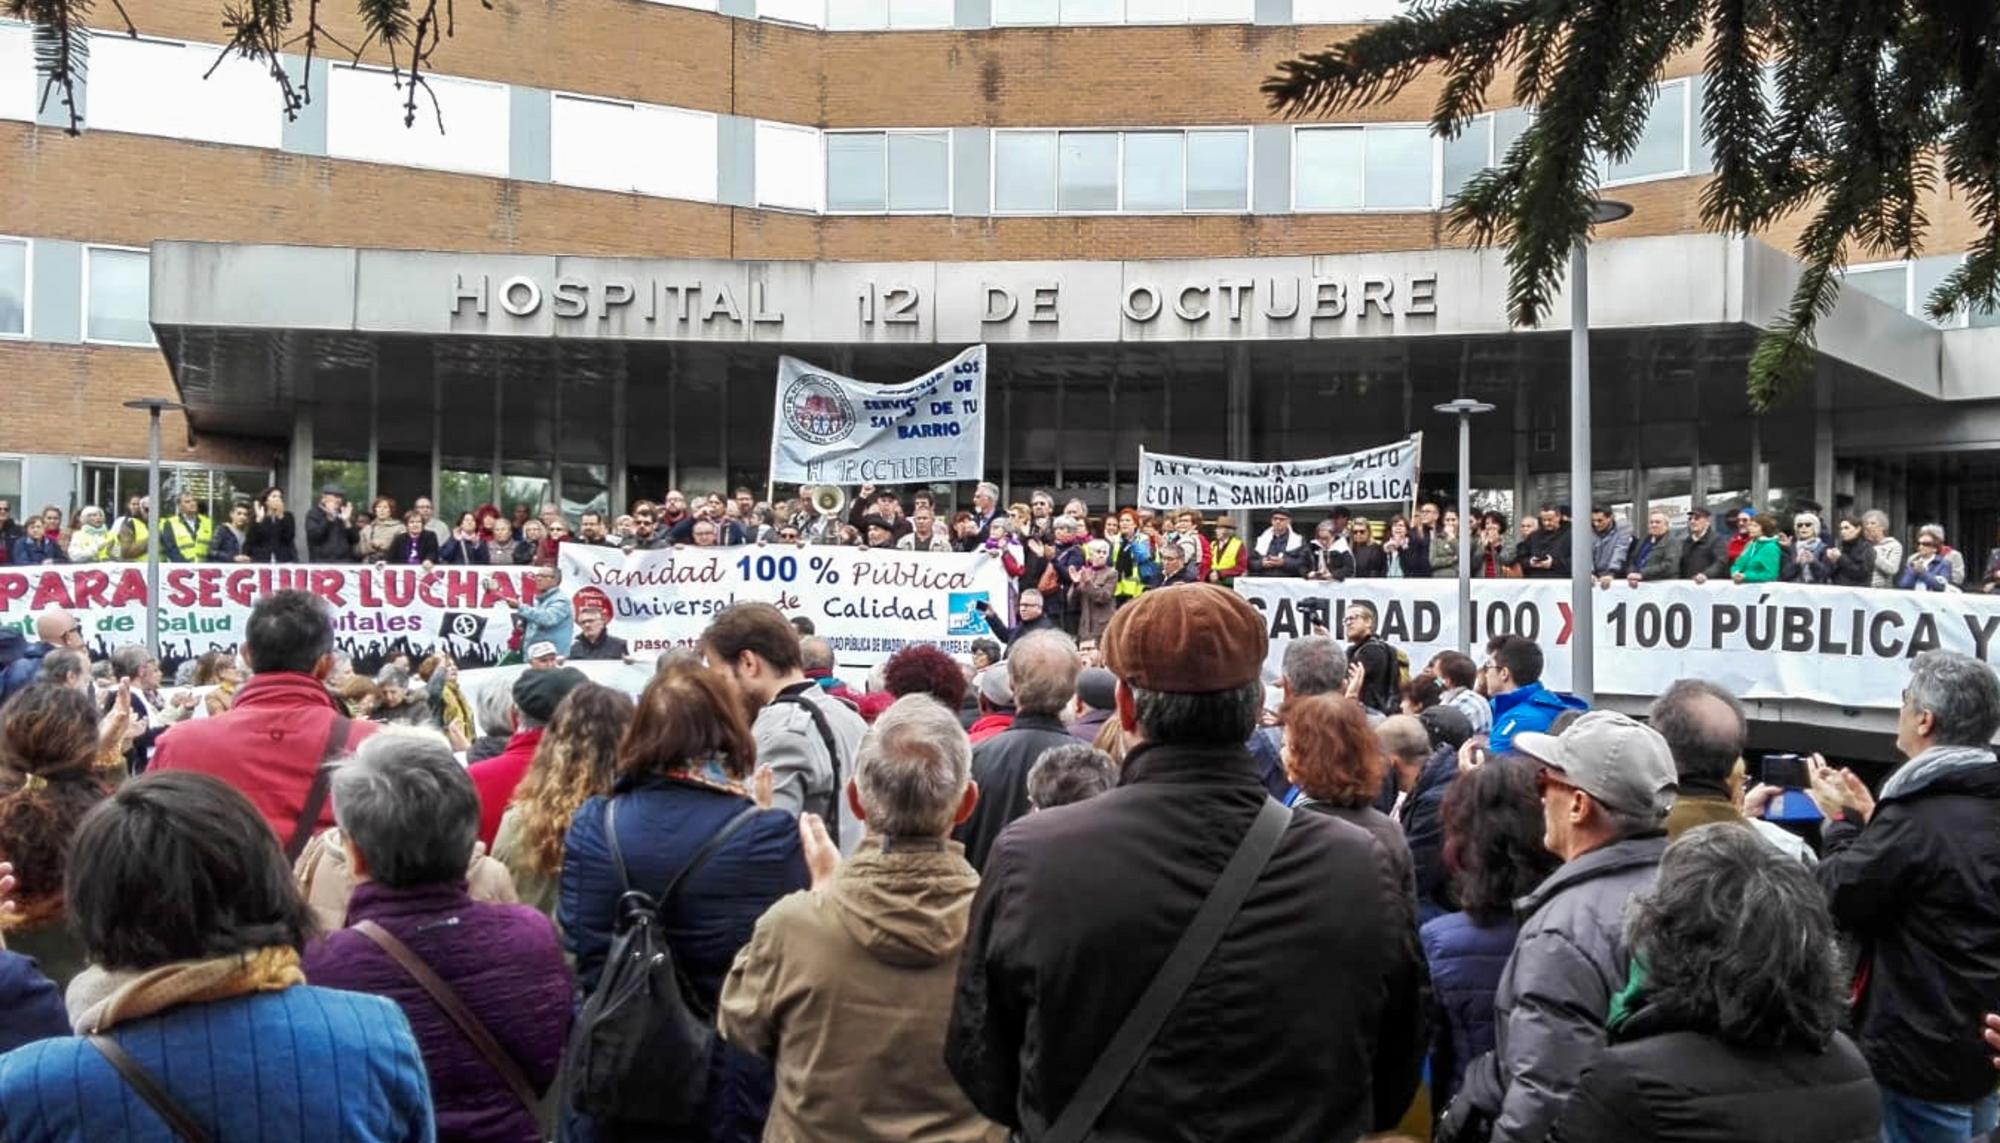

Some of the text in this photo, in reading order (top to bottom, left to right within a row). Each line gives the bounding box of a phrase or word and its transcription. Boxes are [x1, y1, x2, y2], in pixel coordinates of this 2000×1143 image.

[451, 272, 1438, 324] HOSPITAL 12 DE OCTUBRE
[953, 361, 980, 374] LOS
[863, 386, 938, 410] SERVICS
[953, 380, 974, 393] DE
[930, 401, 954, 416] DE
[897, 421, 961, 440] BARRIO
[1352, 448, 1400, 470] ALTO
[1146, 473, 1413, 506] CON LA SANIDAD PÚBLICA
[590, 555, 974, 590] Sanidad 100 % Pública
[0, 568, 148, 612] PARA
[97, 615, 135, 632] de
[157, 608, 232, 634] Salud
[775, 590, 802, 611] de
[823, 596, 937, 622] Calidad
[1607, 602, 1692, 648] 100
[1711, 593, 1942, 660] PÚBLICA
[1963, 614, 2000, 662] Y
[633, 639, 671, 652] paso
